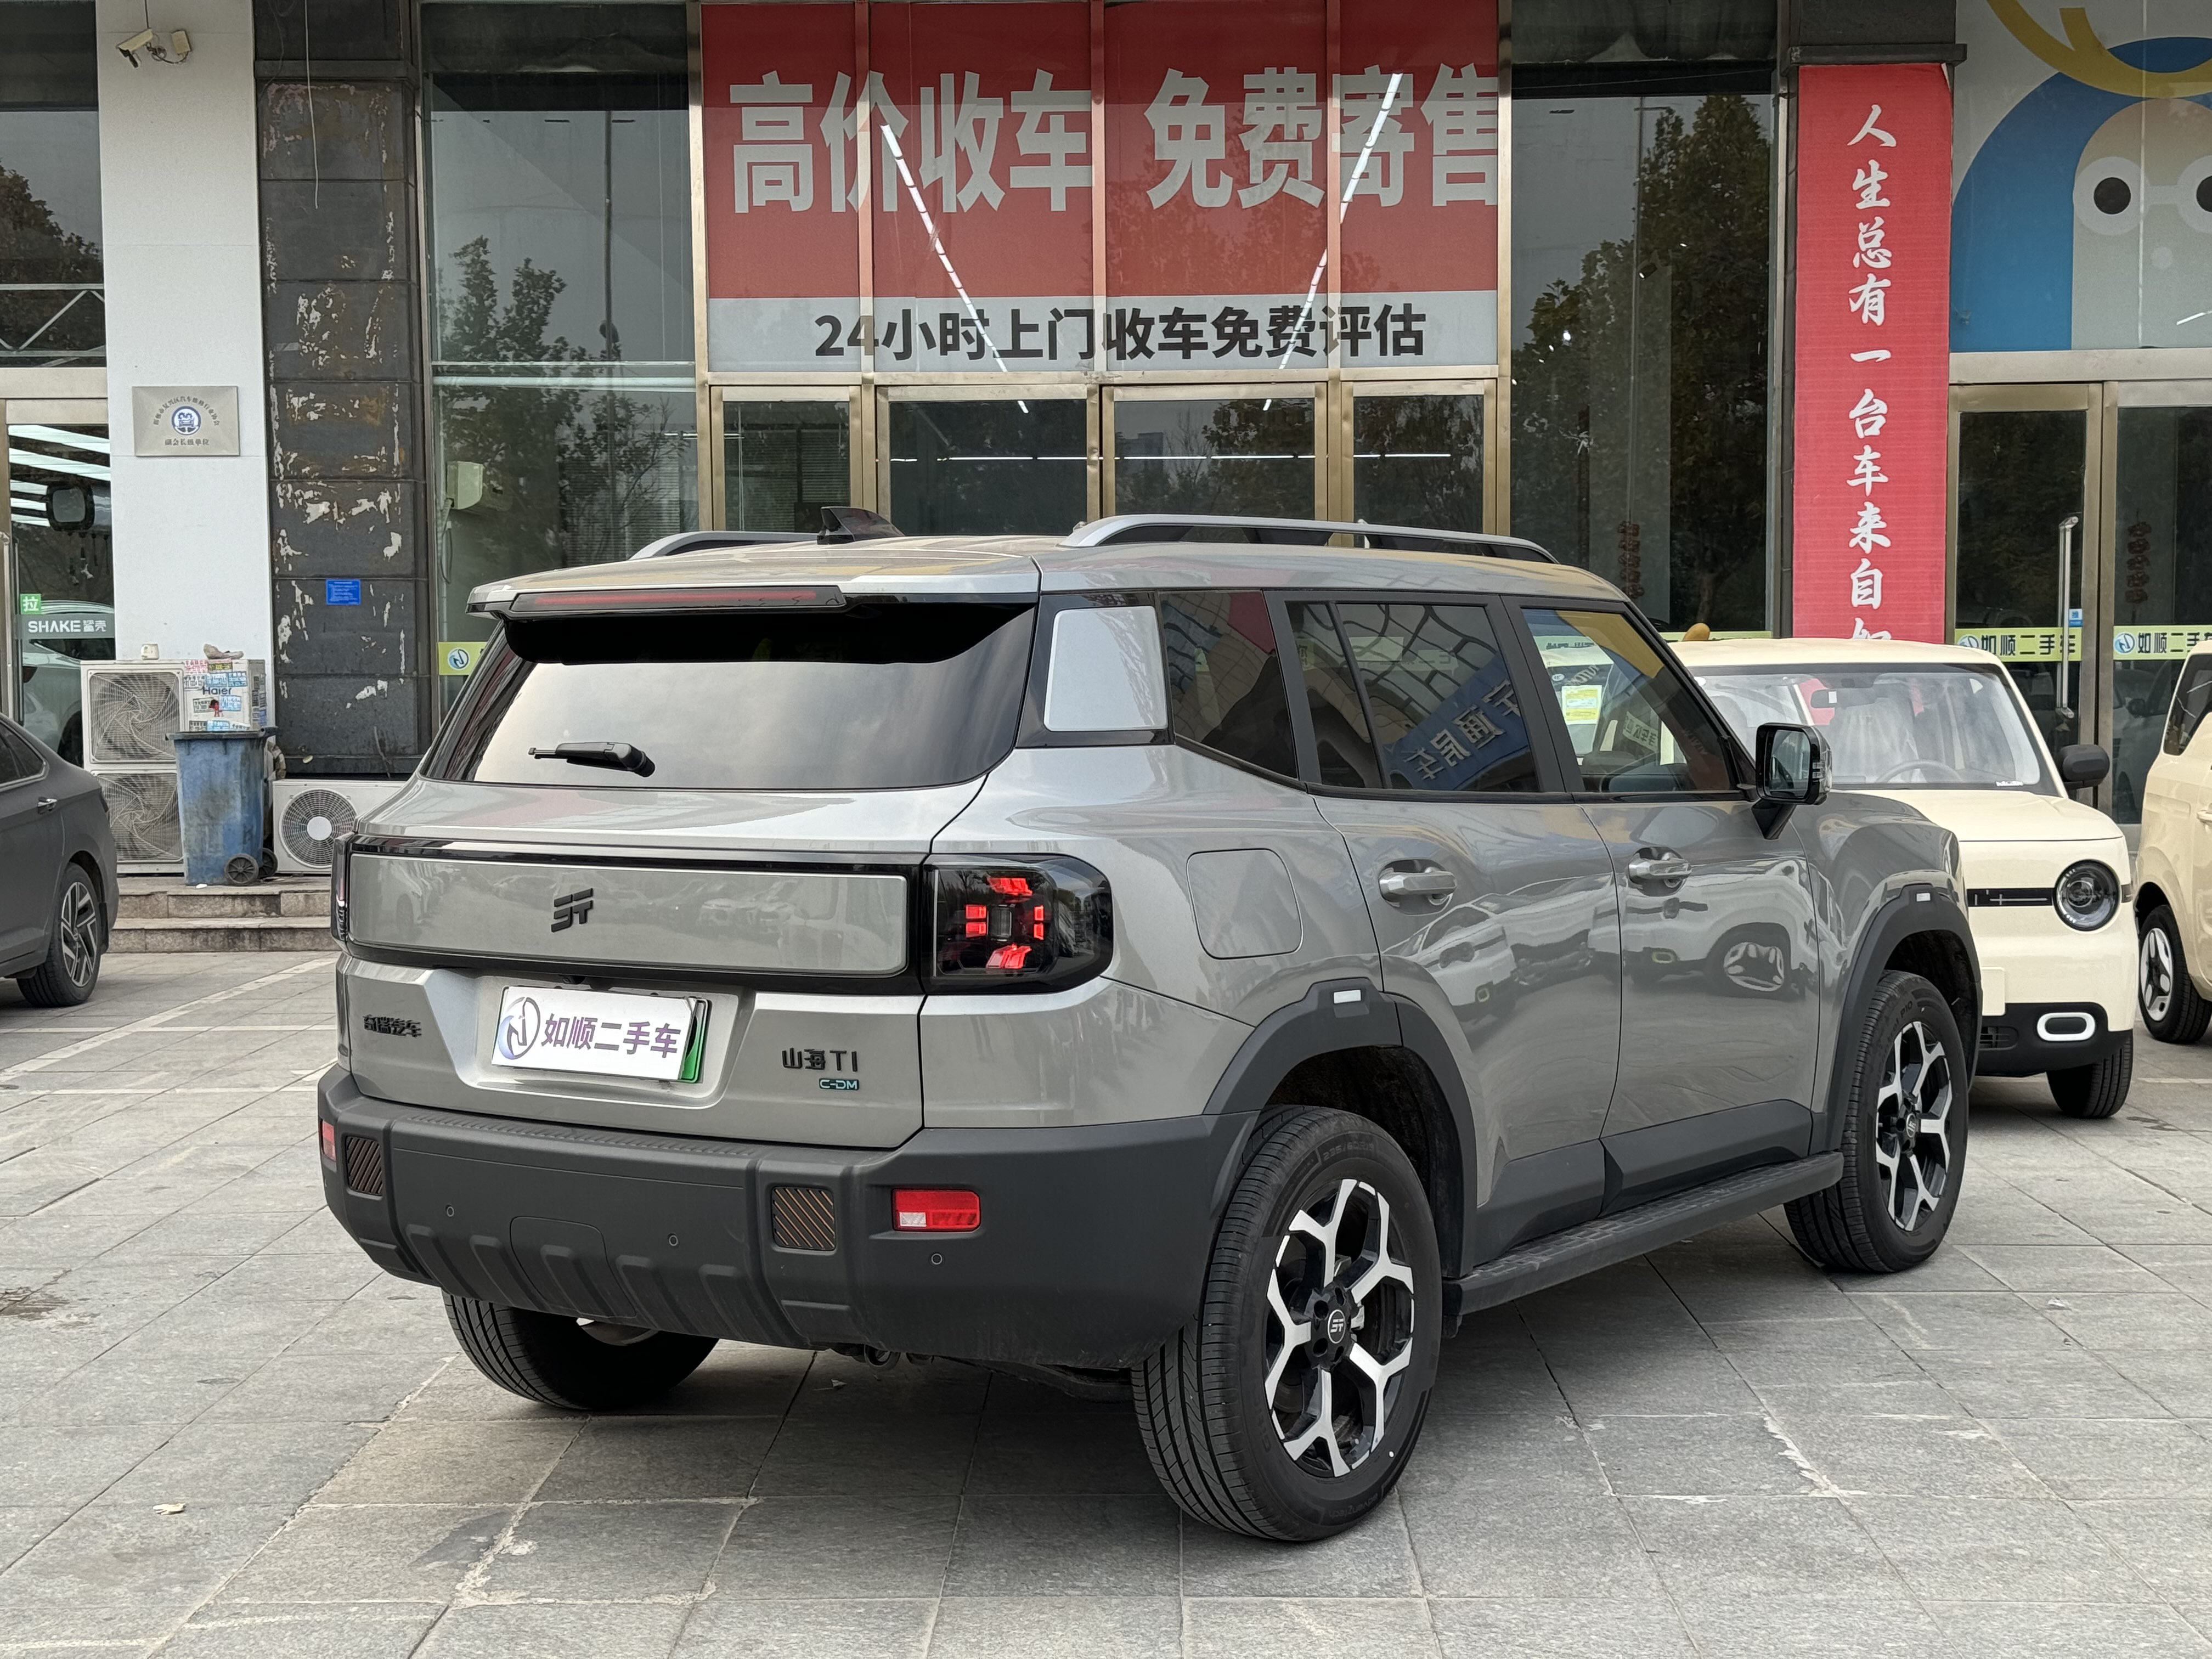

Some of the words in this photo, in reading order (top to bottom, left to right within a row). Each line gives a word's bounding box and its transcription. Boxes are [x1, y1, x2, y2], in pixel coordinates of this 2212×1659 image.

[730, 69, 1093, 214] 高价收车
[1143, 63, 1498, 210] 免费寄售
[814, 303, 1426, 362] 24小时上门收车免费评估
[22, 596, 40, 612] 拉
[28, 620, 82, 633] SHAKE
[1981, 634, 2076, 656] 如顺二手车
[202, 686, 232, 695] Haier
[541, 1013, 681, 1059] 如顺二手车
[820, 1079, 857, 1090] C-DM
